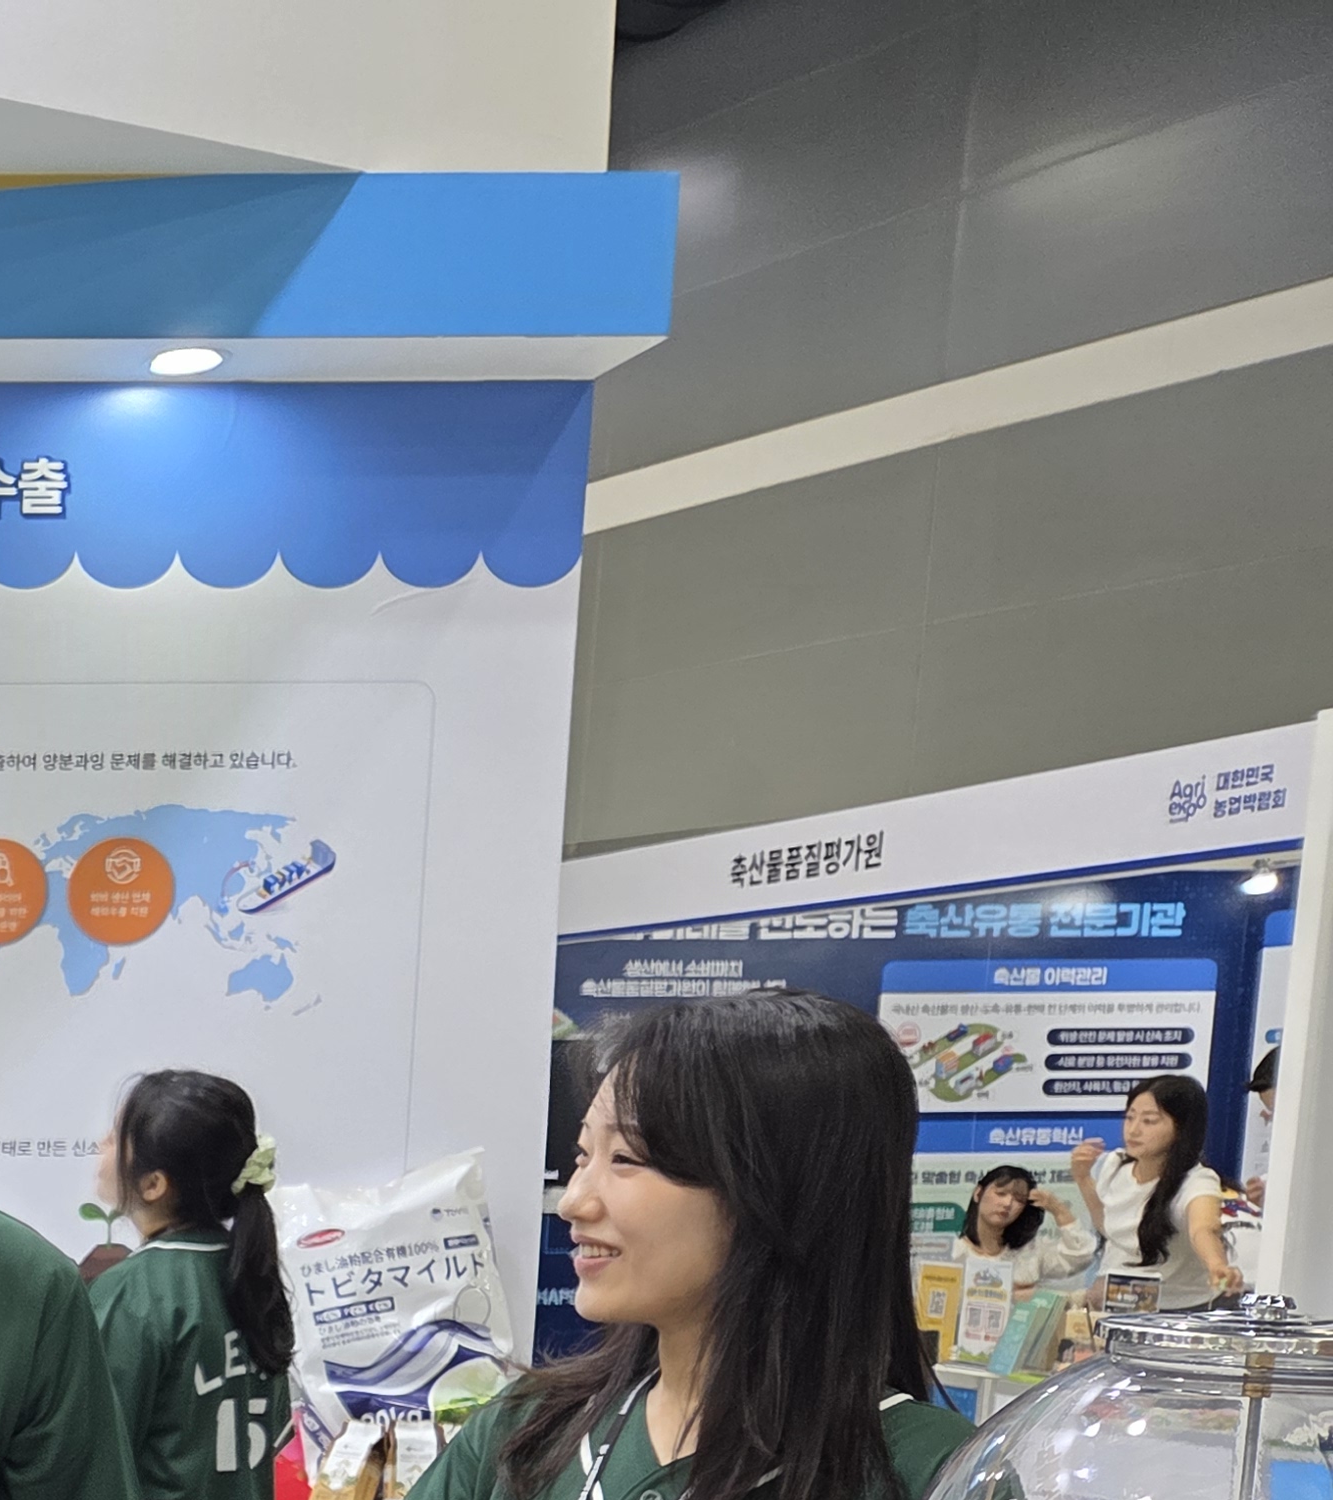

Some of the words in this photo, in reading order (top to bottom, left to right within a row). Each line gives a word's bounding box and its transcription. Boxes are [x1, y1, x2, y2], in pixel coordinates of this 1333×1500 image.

[110, 752, 157, 771] 문제를
[161, 752, 224, 771] 해결하고
[229, 750, 297, 770] 있습니다.
[1216, 764, 1274, 790] 대한민국
[1214, 788, 1287, 818] 농업박람회
[731, 830, 885, 888] 축산물품질평가원
[903, 902, 1041, 938] 축산유통
[1049, 902, 1186, 937] 전문기관
[37, 1141, 67, 1158] 만든
